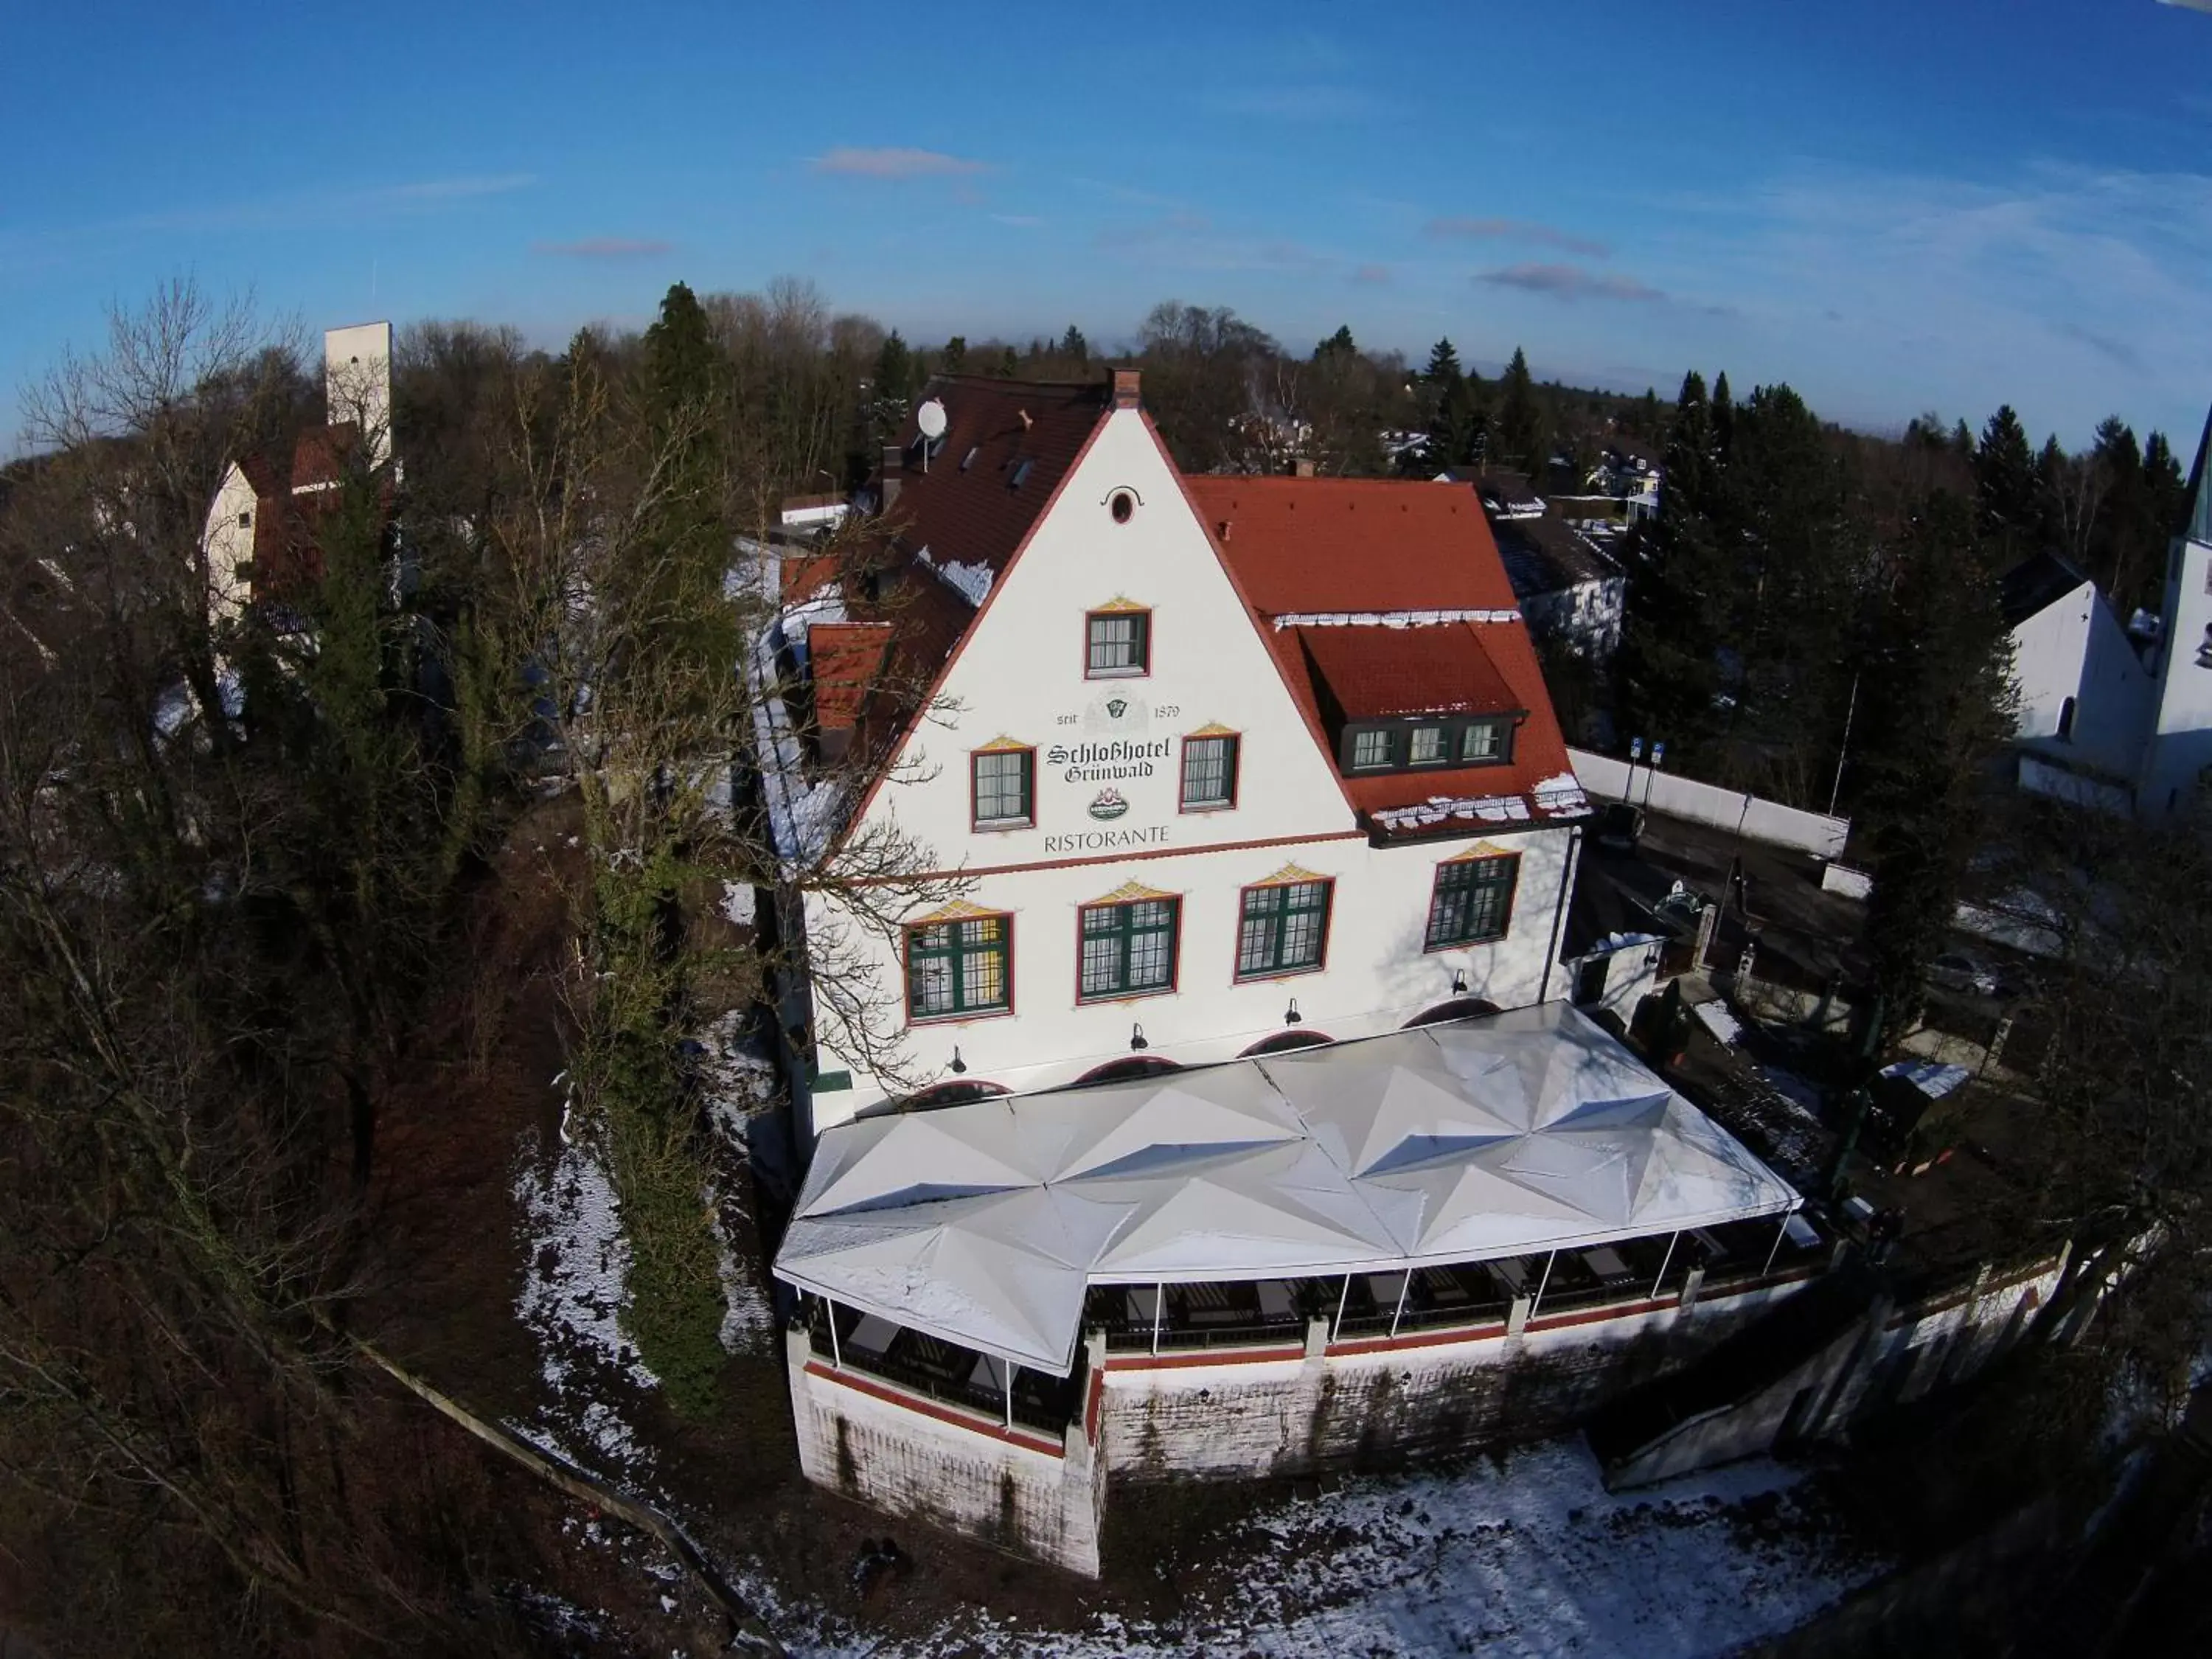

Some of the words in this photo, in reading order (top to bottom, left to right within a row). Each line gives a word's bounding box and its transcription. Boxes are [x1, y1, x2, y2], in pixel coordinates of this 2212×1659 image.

[1057, 714, 1078, 725] seit
[1046, 737, 1170, 765] Schloßhotel
[1065, 762, 1153, 782] Grünwald
[1044, 826, 1169, 852] RISTORANTE
